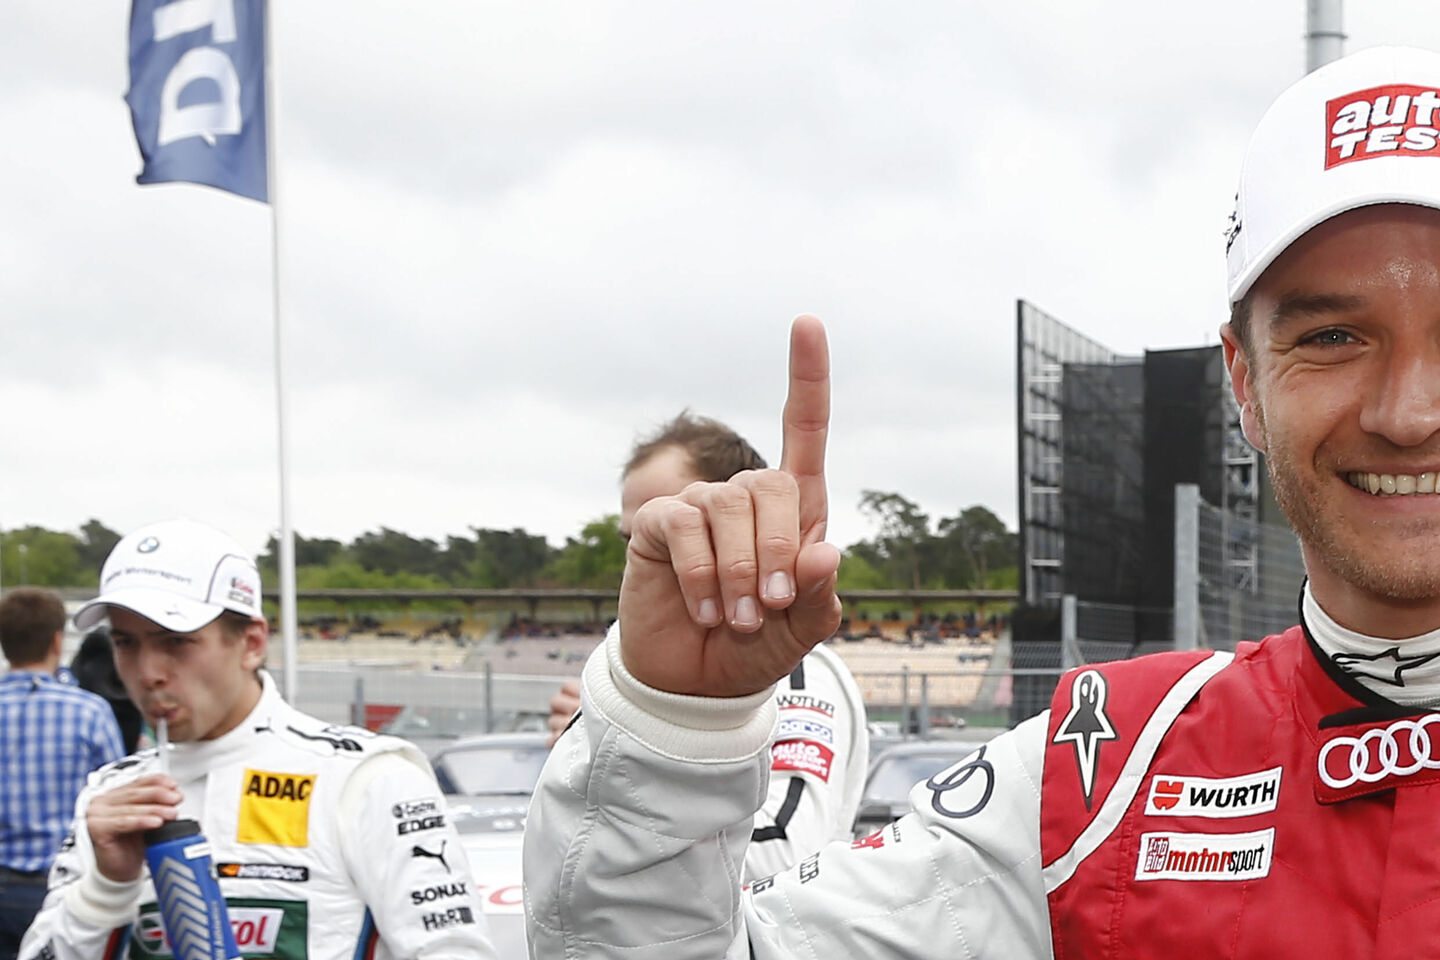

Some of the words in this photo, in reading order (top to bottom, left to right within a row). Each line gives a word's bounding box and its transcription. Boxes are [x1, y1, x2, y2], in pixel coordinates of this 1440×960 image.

[246, 774, 312, 801] ADAC
[397, 815, 446, 836] EDGE
[411, 882, 468, 905] SONAX
